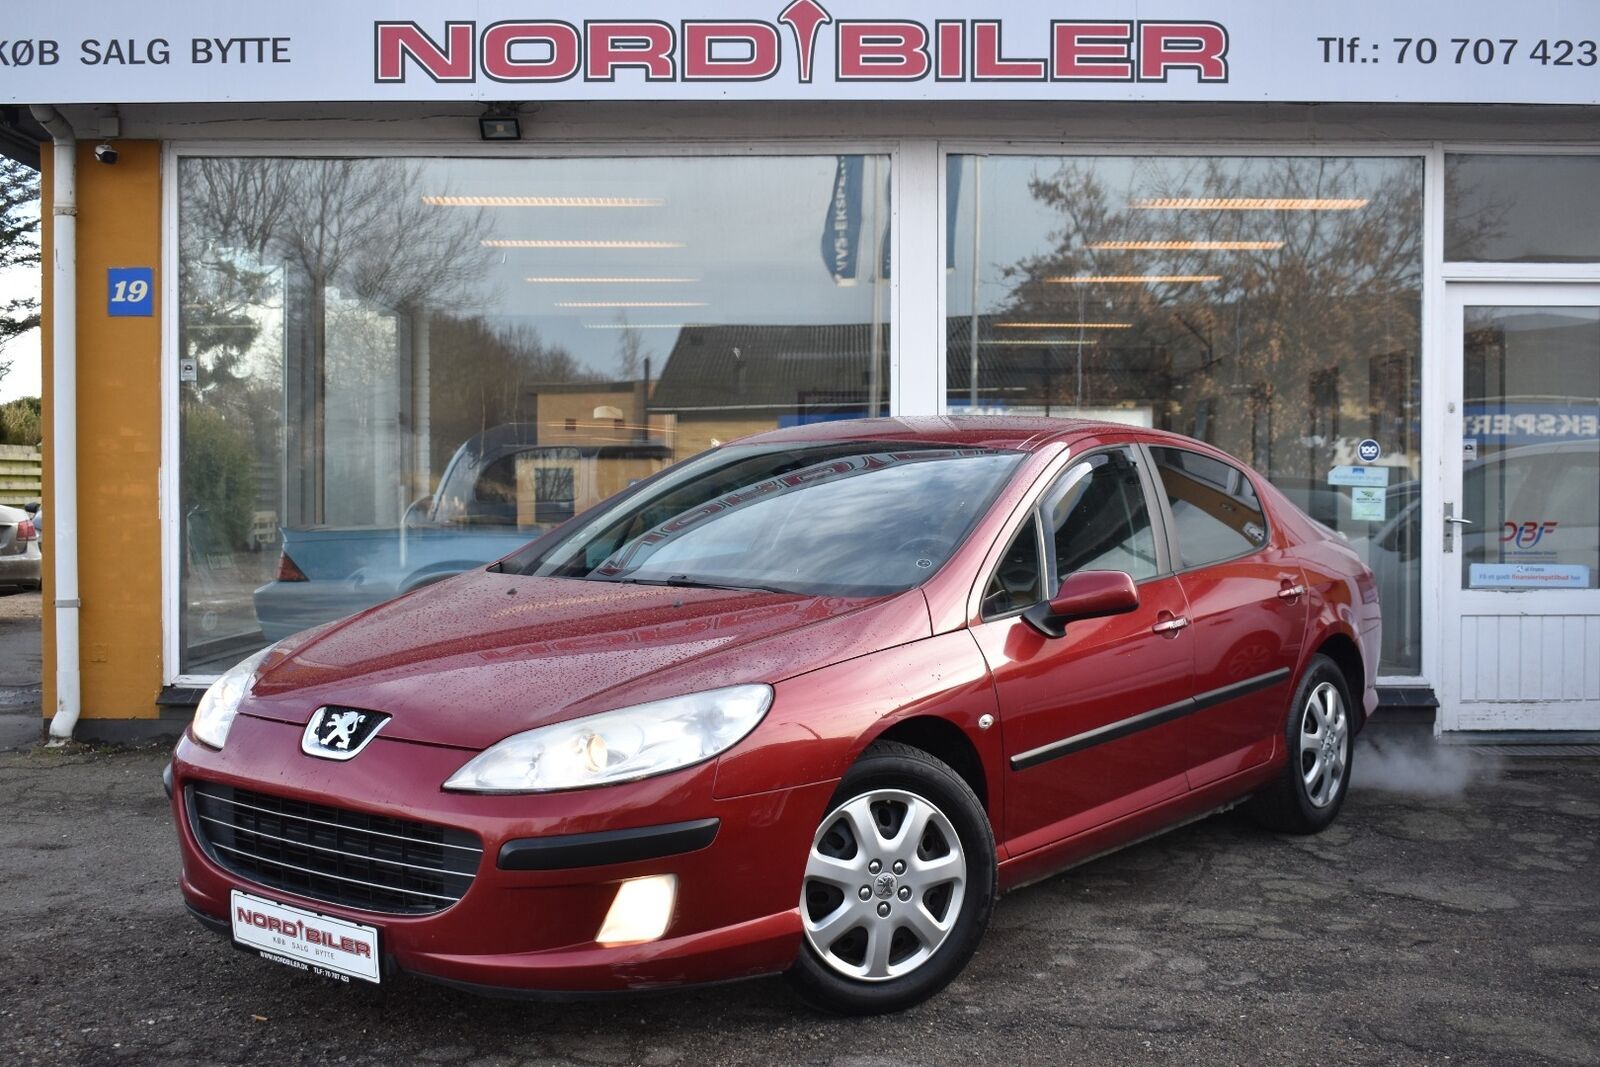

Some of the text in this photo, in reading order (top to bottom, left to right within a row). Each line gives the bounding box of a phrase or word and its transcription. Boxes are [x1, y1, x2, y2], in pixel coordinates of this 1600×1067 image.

[80, 38, 171, 65] SALG
[191, 37, 291, 64] BYTTE
[374, 19, 1230, 83] NORD BILER
[1317, 37, 1598, 66] Tlf.: 70 707 423
[111, 279, 149, 303] 19
[236, 906, 372, 959] NORD BILER
[291, 942, 309, 952] SALG
[315, 949, 335, 960] BYTTE
